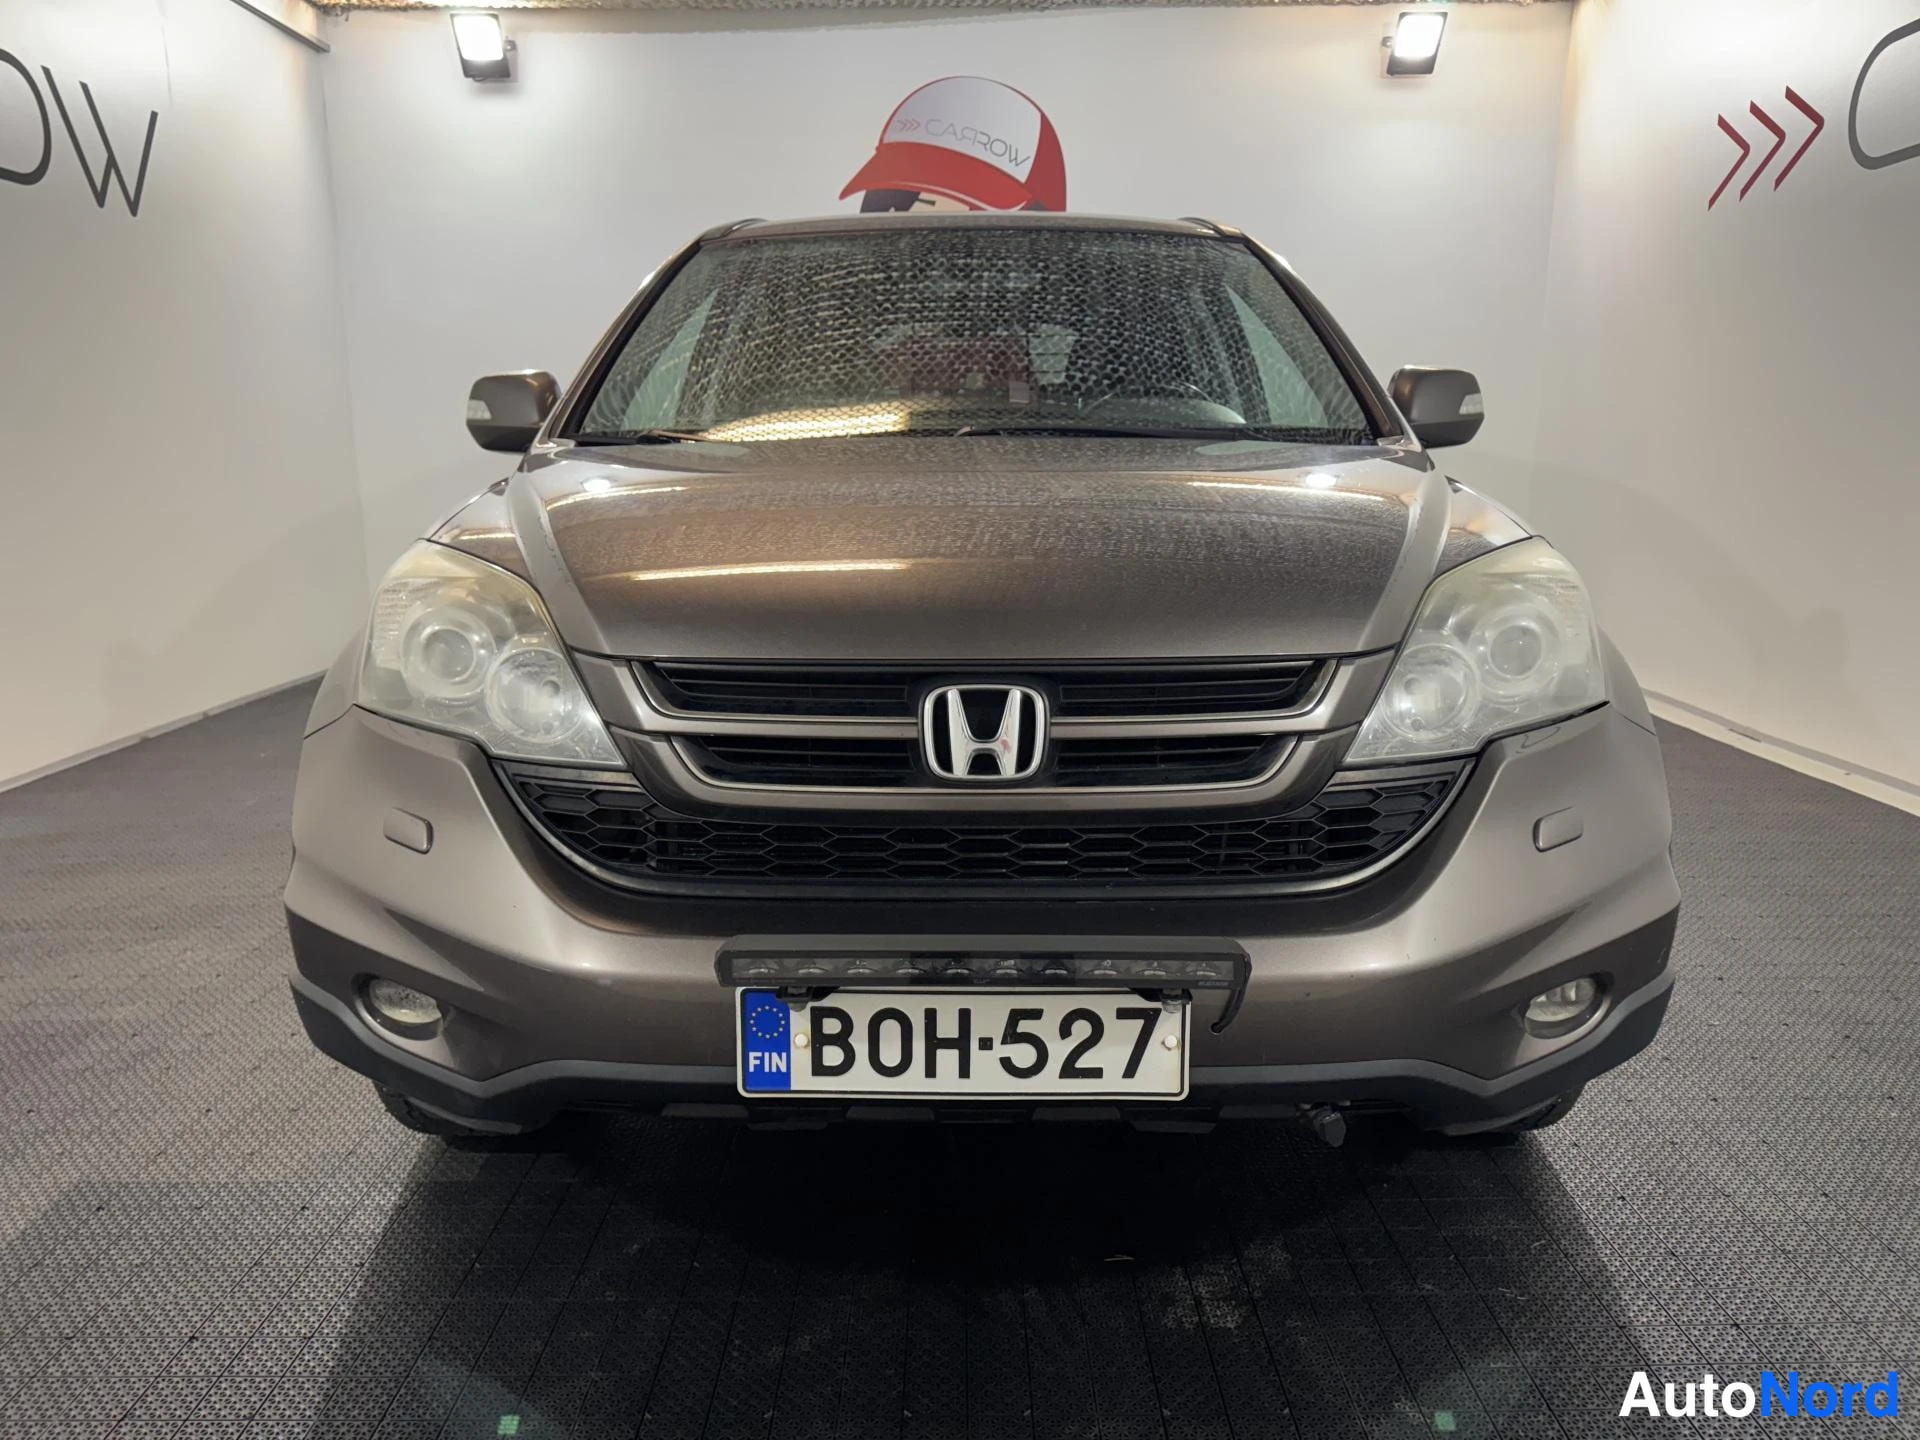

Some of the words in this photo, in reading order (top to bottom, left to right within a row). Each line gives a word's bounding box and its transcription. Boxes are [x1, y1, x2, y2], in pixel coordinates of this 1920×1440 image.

[925, 119, 1031, 167] CARROW
[748, 1052, 787, 1073] FIN
[810, 1006, 1162, 1079] BOH-527
